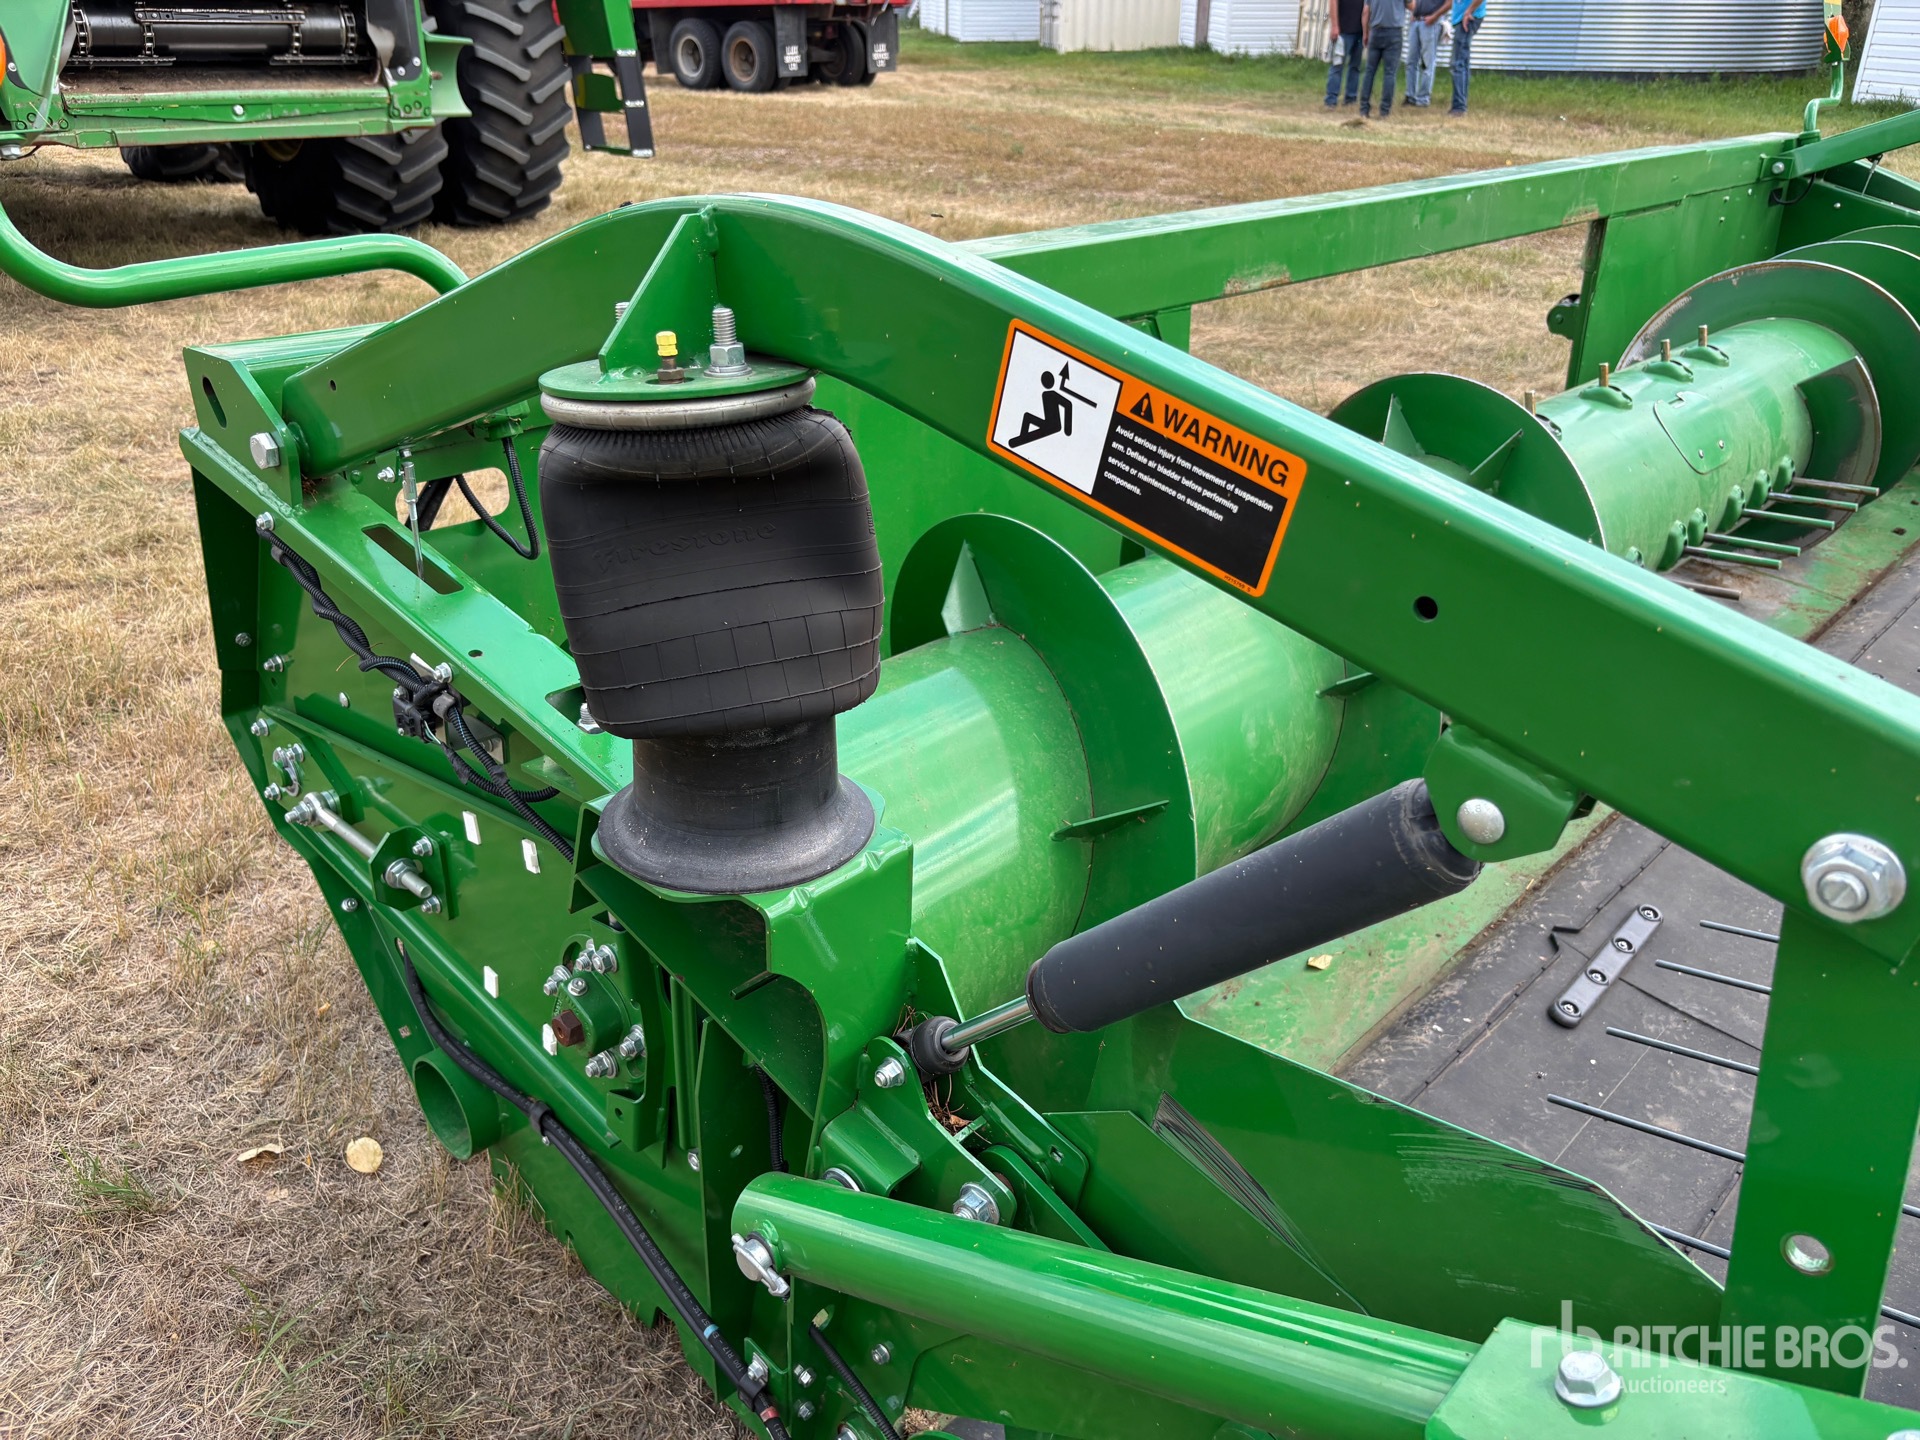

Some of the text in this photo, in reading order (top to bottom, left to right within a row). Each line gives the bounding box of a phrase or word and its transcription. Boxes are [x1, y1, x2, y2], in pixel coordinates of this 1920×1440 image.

[1111, 441, 1239, 513] arm. Deflate air bladder before performing
[1115, 425, 1274, 512] Avoid serious injury from movement of suspension
[1163, 404, 1289, 487] WARNING
[1103, 470, 1142, 496] components.
[1107, 456, 1224, 522] service or maintenance on suspension
[592, 521, 777, 575] Firestone
